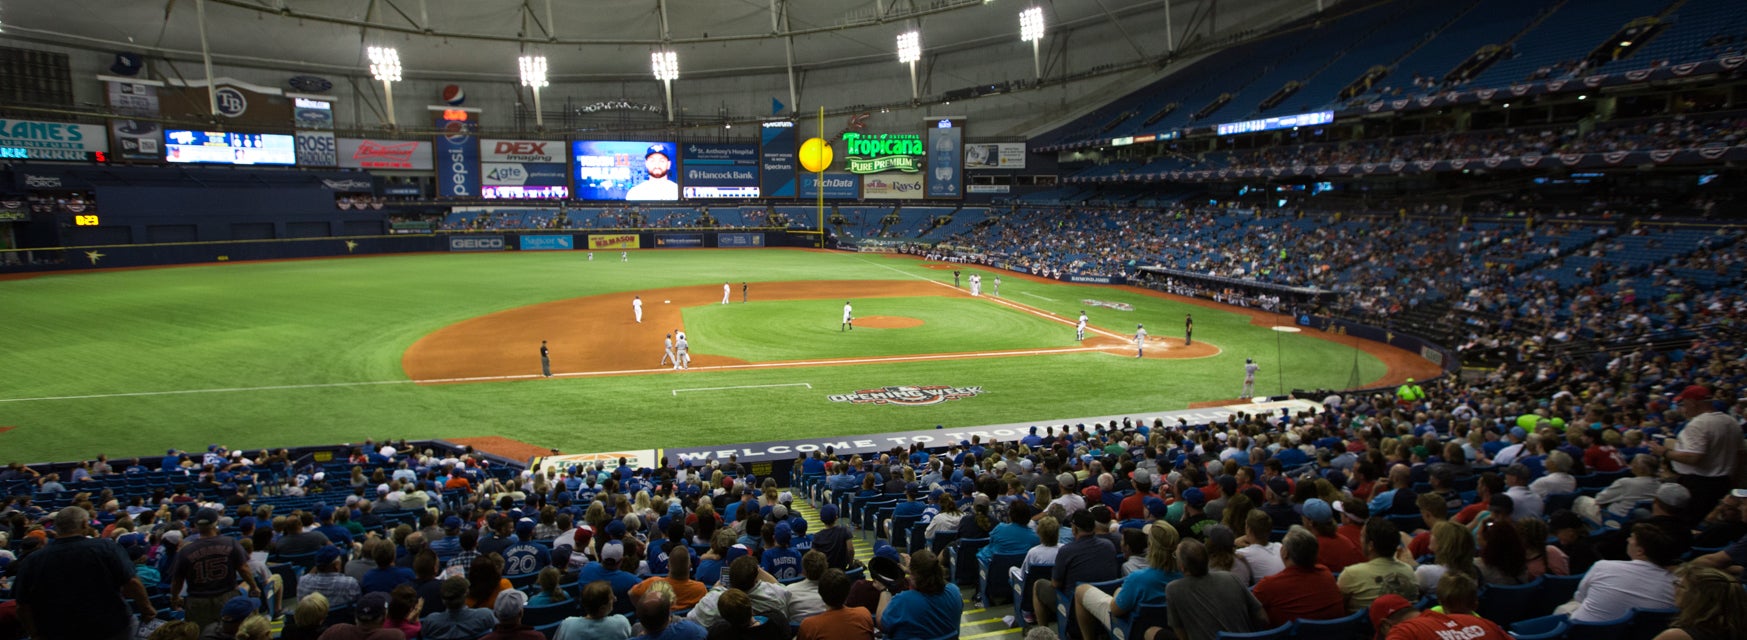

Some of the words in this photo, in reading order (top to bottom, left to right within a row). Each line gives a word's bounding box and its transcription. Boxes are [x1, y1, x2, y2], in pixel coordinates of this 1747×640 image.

[297, 135, 335, 151] ROSE
[494, 142, 548, 155] DEX
[843, 132, 923, 158] Tropicana
[851, 161, 873, 171] PURE
[874, 158, 913, 170] PREMIUM
[448, 148, 470, 196] pepsi
[500, 166, 521, 178] gte
[698, 170, 732, 179] Hancock
[733, 171, 753, 179] Bank
[892, 181, 914, 192] Rays
[452, 239, 503, 249] GEICO
[677, 439, 877, 460] WELCOME
[887, 434, 935, 446] TO
[192, 557, 229, 584] 15
[507, 554, 537, 574] 20
